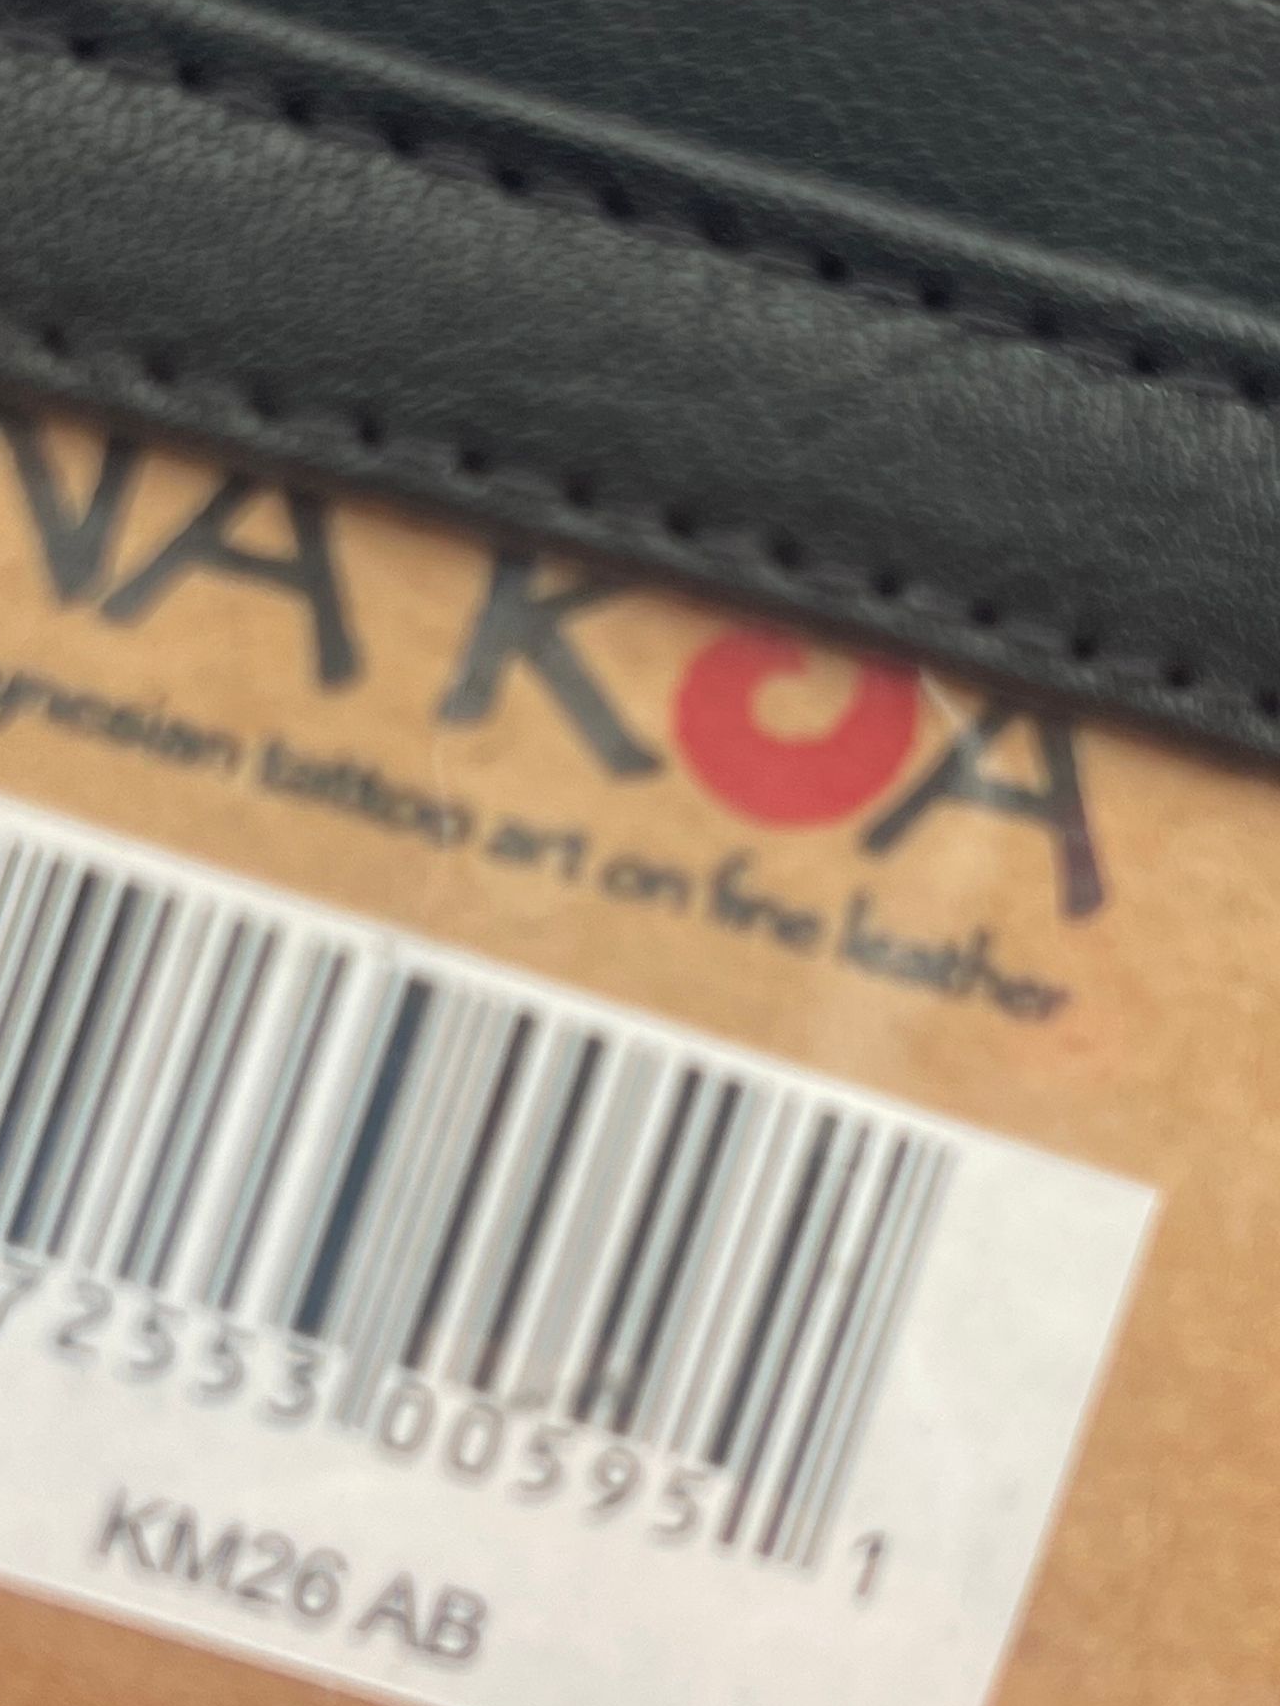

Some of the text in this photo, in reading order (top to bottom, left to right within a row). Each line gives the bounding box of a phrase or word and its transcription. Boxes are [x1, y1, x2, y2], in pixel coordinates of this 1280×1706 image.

[257, 736, 473, 850] tattoo
[485, 815, 590, 885] art
[598, 850, 696, 915] on
[705, 845, 823, 963] fine
[836, 890, 1072, 1023] leather
[95, 1488, 490, 1663] KM26 AB
[377, 1377, 713, 1538] 00595
[852, 1528, 888, 1600] 1
